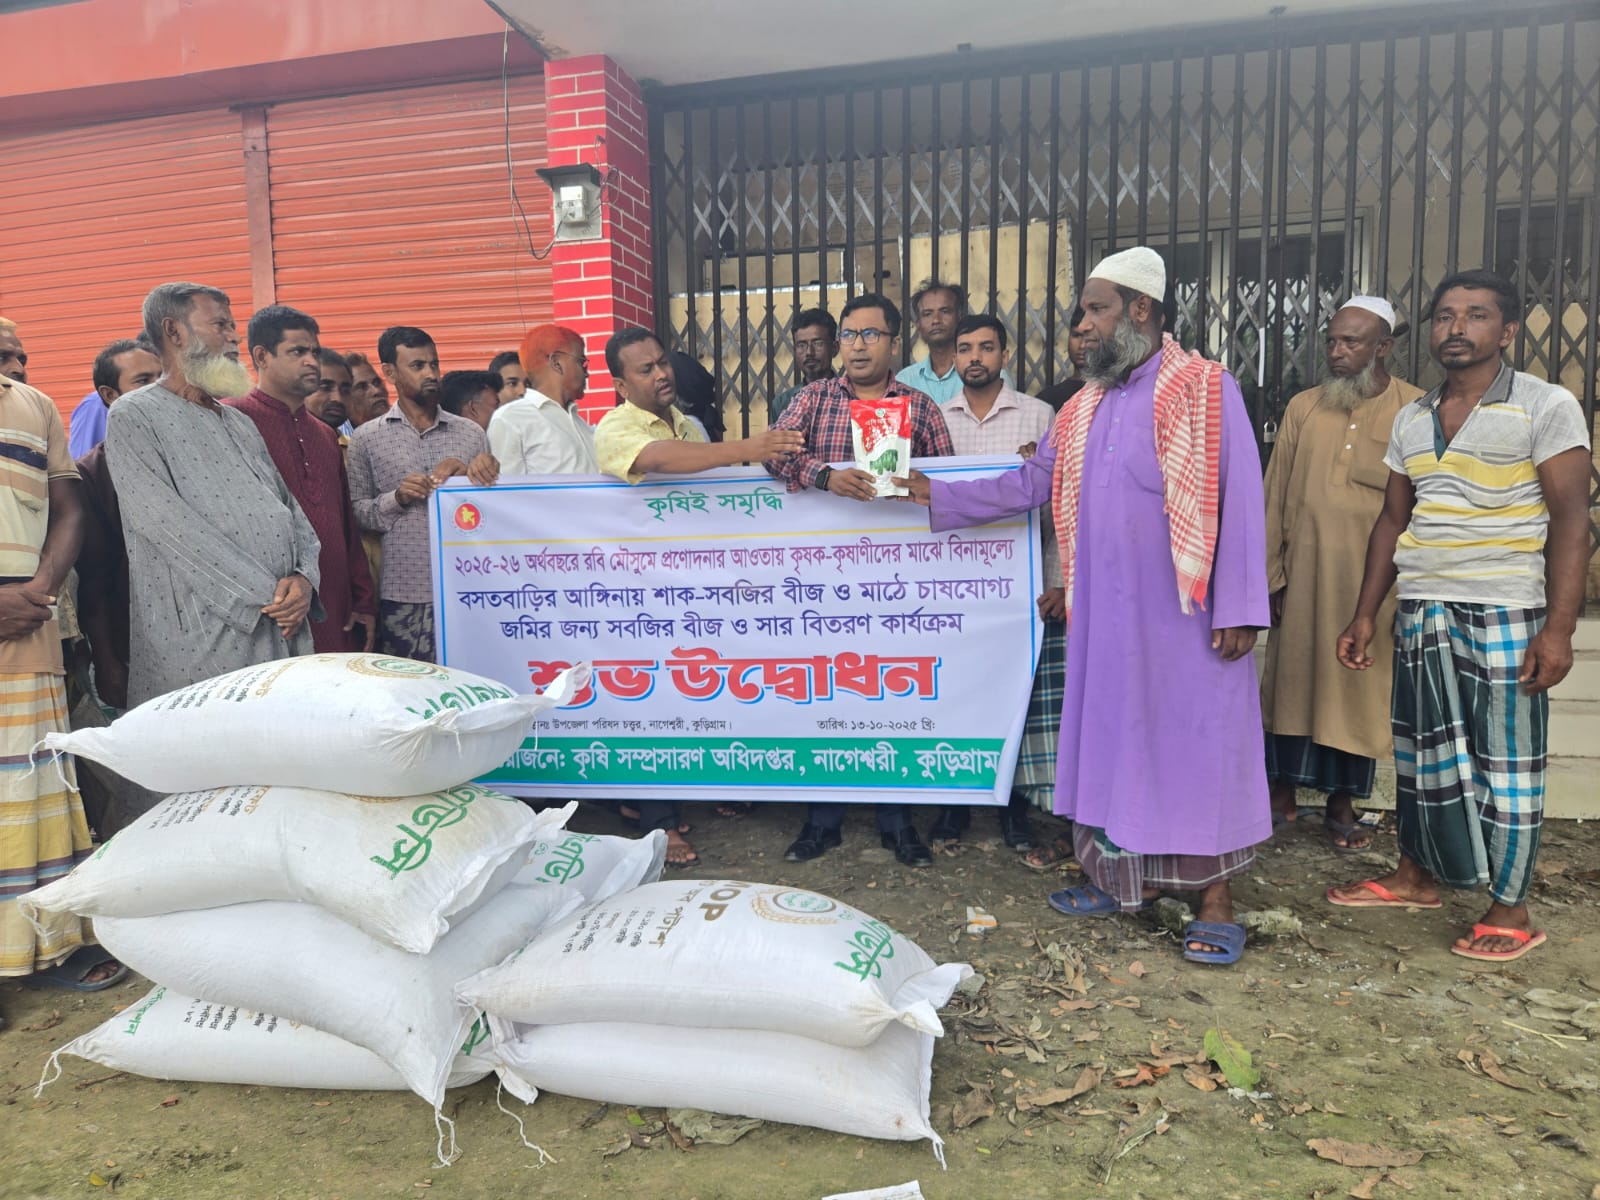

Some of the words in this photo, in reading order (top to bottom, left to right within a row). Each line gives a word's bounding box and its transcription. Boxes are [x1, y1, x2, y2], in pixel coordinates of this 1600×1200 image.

[643, 488, 710, 522] কৃষিই
[715, 485, 785, 518] সমৃদ্ধি
[455, 555, 520, 577] ২০২৫-২৬
[524, 546, 580, 573] অর্থবছরে
[582, 546, 606, 573] রবি
[609, 546, 657, 575] মৌসুমে
[661, 548, 726, 570] প্রণোদনার
[730, 546, 785, 568] আওতায়
[789, 536, 903, 575] কৃষক-কৃষাণীদের
[906, 538, 944, 563] মাঝে
[947, 533, 1016, 568] বিনামূল্যে
[456, 583, 557, 612] বসতবাড়ির
[563, 582, 646, 609] আঙ্গিনায়
[652, 578, 776, 607] শাক-সবজির
[781, 576, 826, 605] বীজ
[833, 583, 851, 601] ও
[858, 572, 909, 602] মাঠে
[915, 576, 1014, 601] চাষযোগ্য
[500, 614, 552, 640] জমির
[558, 619, 601, 640] জন্য
[606, 612, 676, 639] সবজির
[681, 611, 724, 639] বীজ
[730, 618, 748, 636] ও
[754, 615, 794, 637] সার
[800, 609, 874, 637] বিতরণ
[878, 605, 965, 635] কার্যক্রম
[664, 645, 943, 706] উদ্বোধন
[552, 718, 588, 730] উপজেলা
[591, 717, 620, 730] পরিষদ
[851, 720, 918, 732] ১৩-১০-২০২৫
[570, 741, 611, 779] কৃষি
[615, 747, 705, 773] সম্প্রসারণ
